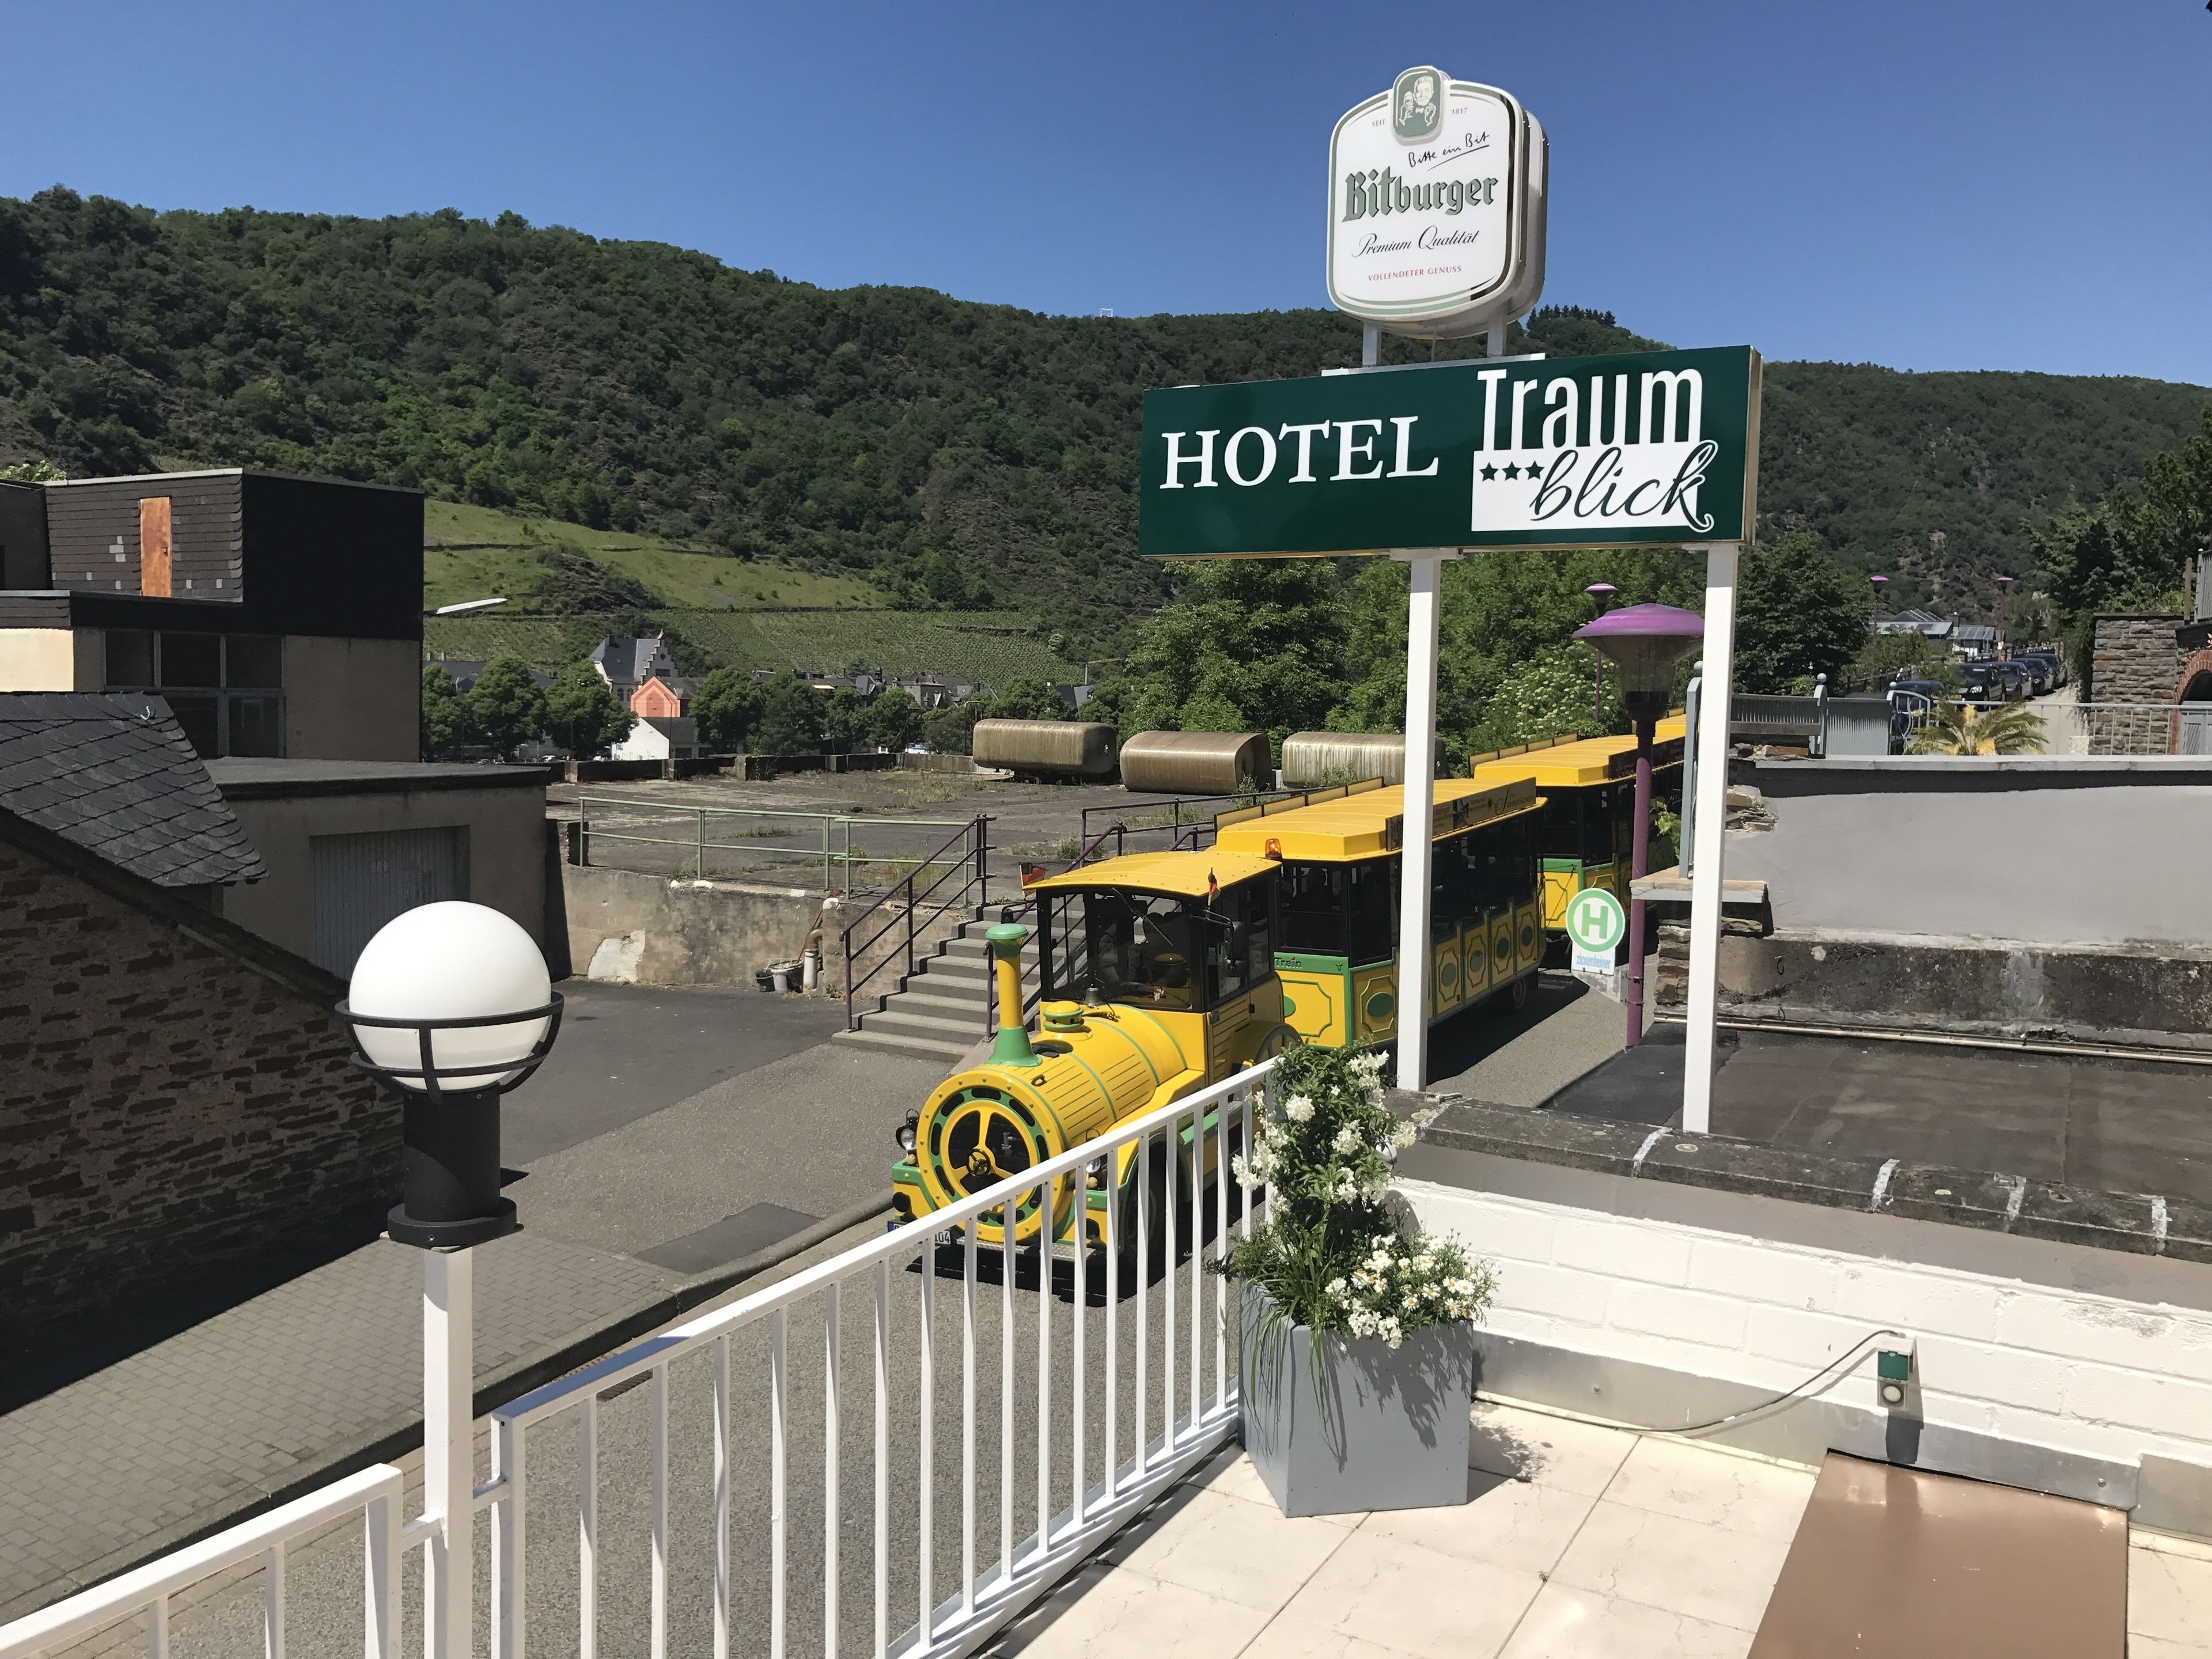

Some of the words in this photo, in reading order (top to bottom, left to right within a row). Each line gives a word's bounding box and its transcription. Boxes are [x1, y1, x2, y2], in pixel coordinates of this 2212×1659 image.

[1372, 119, 1385, 127] SEIT
[1408, 151, 1437, 167] Bitte
[1442, 146, 1461, 155] ein
[1465, 131, 1490, 147] Bit
[1341, 166, 1498, 222] Bitburger
[1351, 233, 1411, 257] Premium
[1418, 225, 1479, 249] Qualität
[1368, 269, 1424, 281] VOLLENDETER
[1427, 266, 1461, 275] GENUSS
[1477, 368, 1703, 451] Traum
[1159, 415, 1439, 490] HOTEL
[1529, 440, 1719, 533] blick
[1581, 903, 1609, 939] H
[1274, 957, 1302, 968] Train
[934, 1231, 950, 1243] 104
